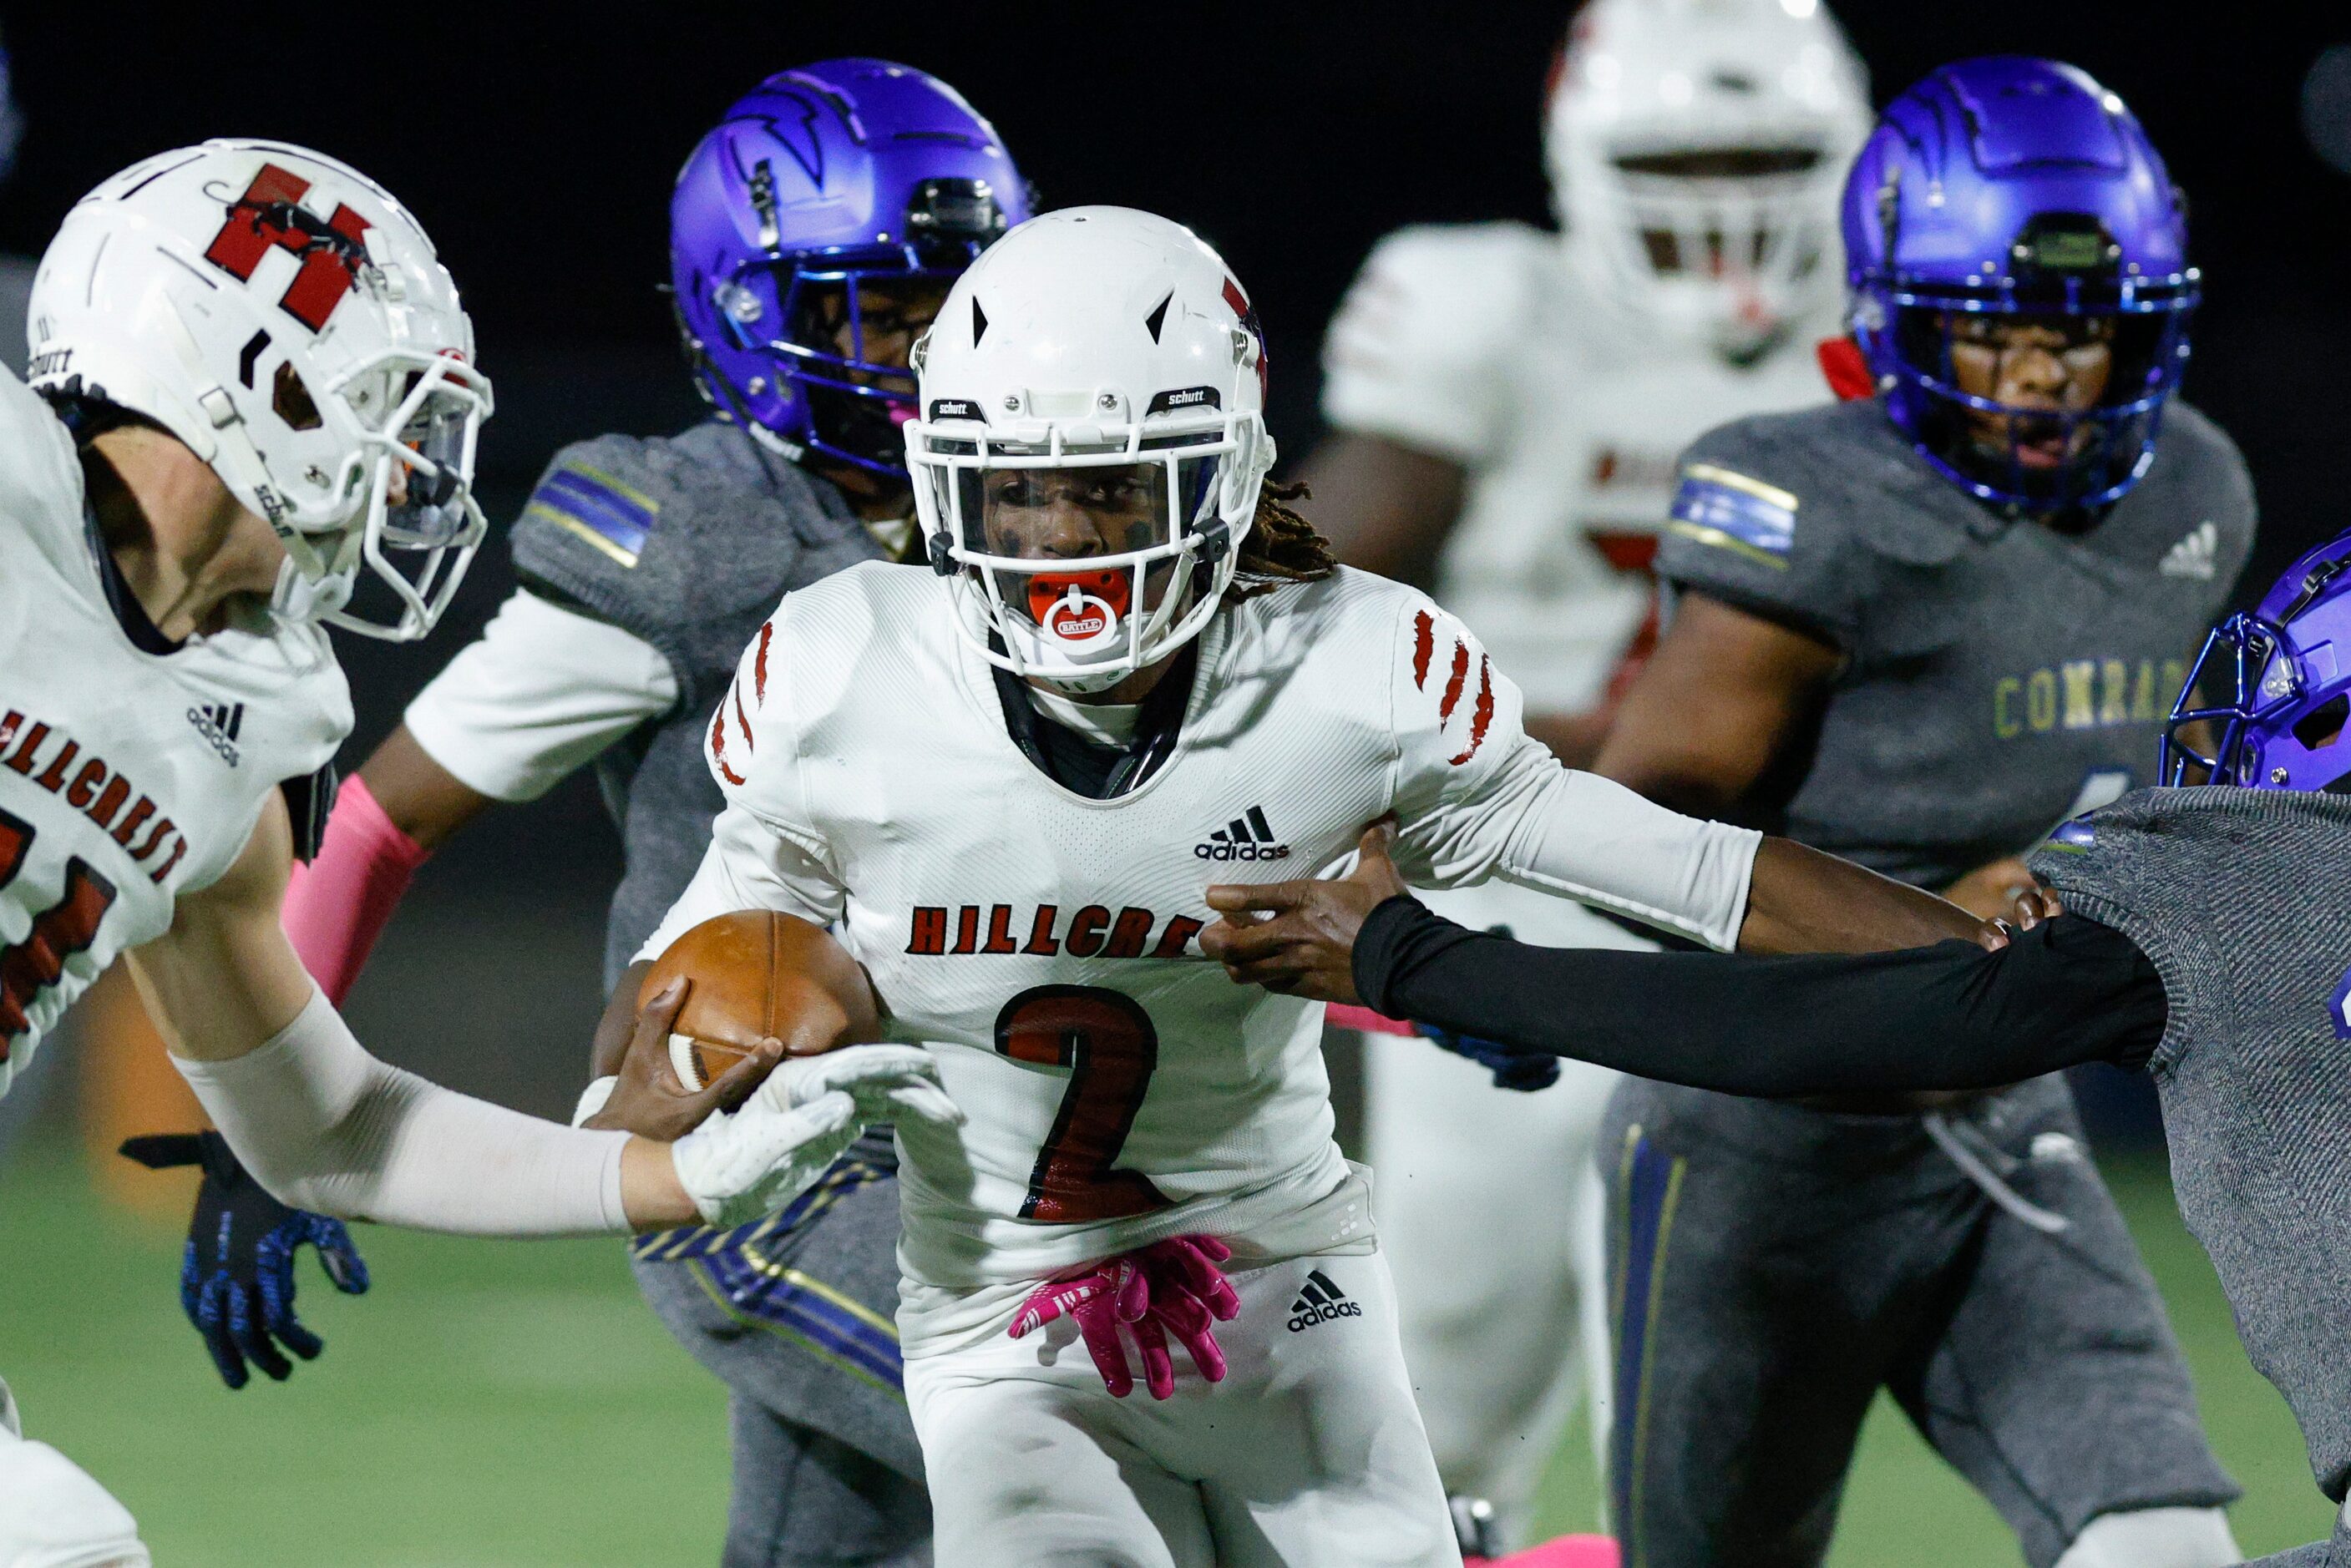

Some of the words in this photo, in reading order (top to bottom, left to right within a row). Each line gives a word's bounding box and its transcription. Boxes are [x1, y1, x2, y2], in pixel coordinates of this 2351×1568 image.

[1168, 389, 1204, 405] schutt
[939, 403, 966, 415] schutt
[1061, 621, 1098, 632] BATTLE
[1194, 842, 1290, 862] adidas
[904, 903, 1208, 959] HILLCRE
[994, 984, 1178, 1222] 2
[1287, 1300, 1362, 1333] adidas
